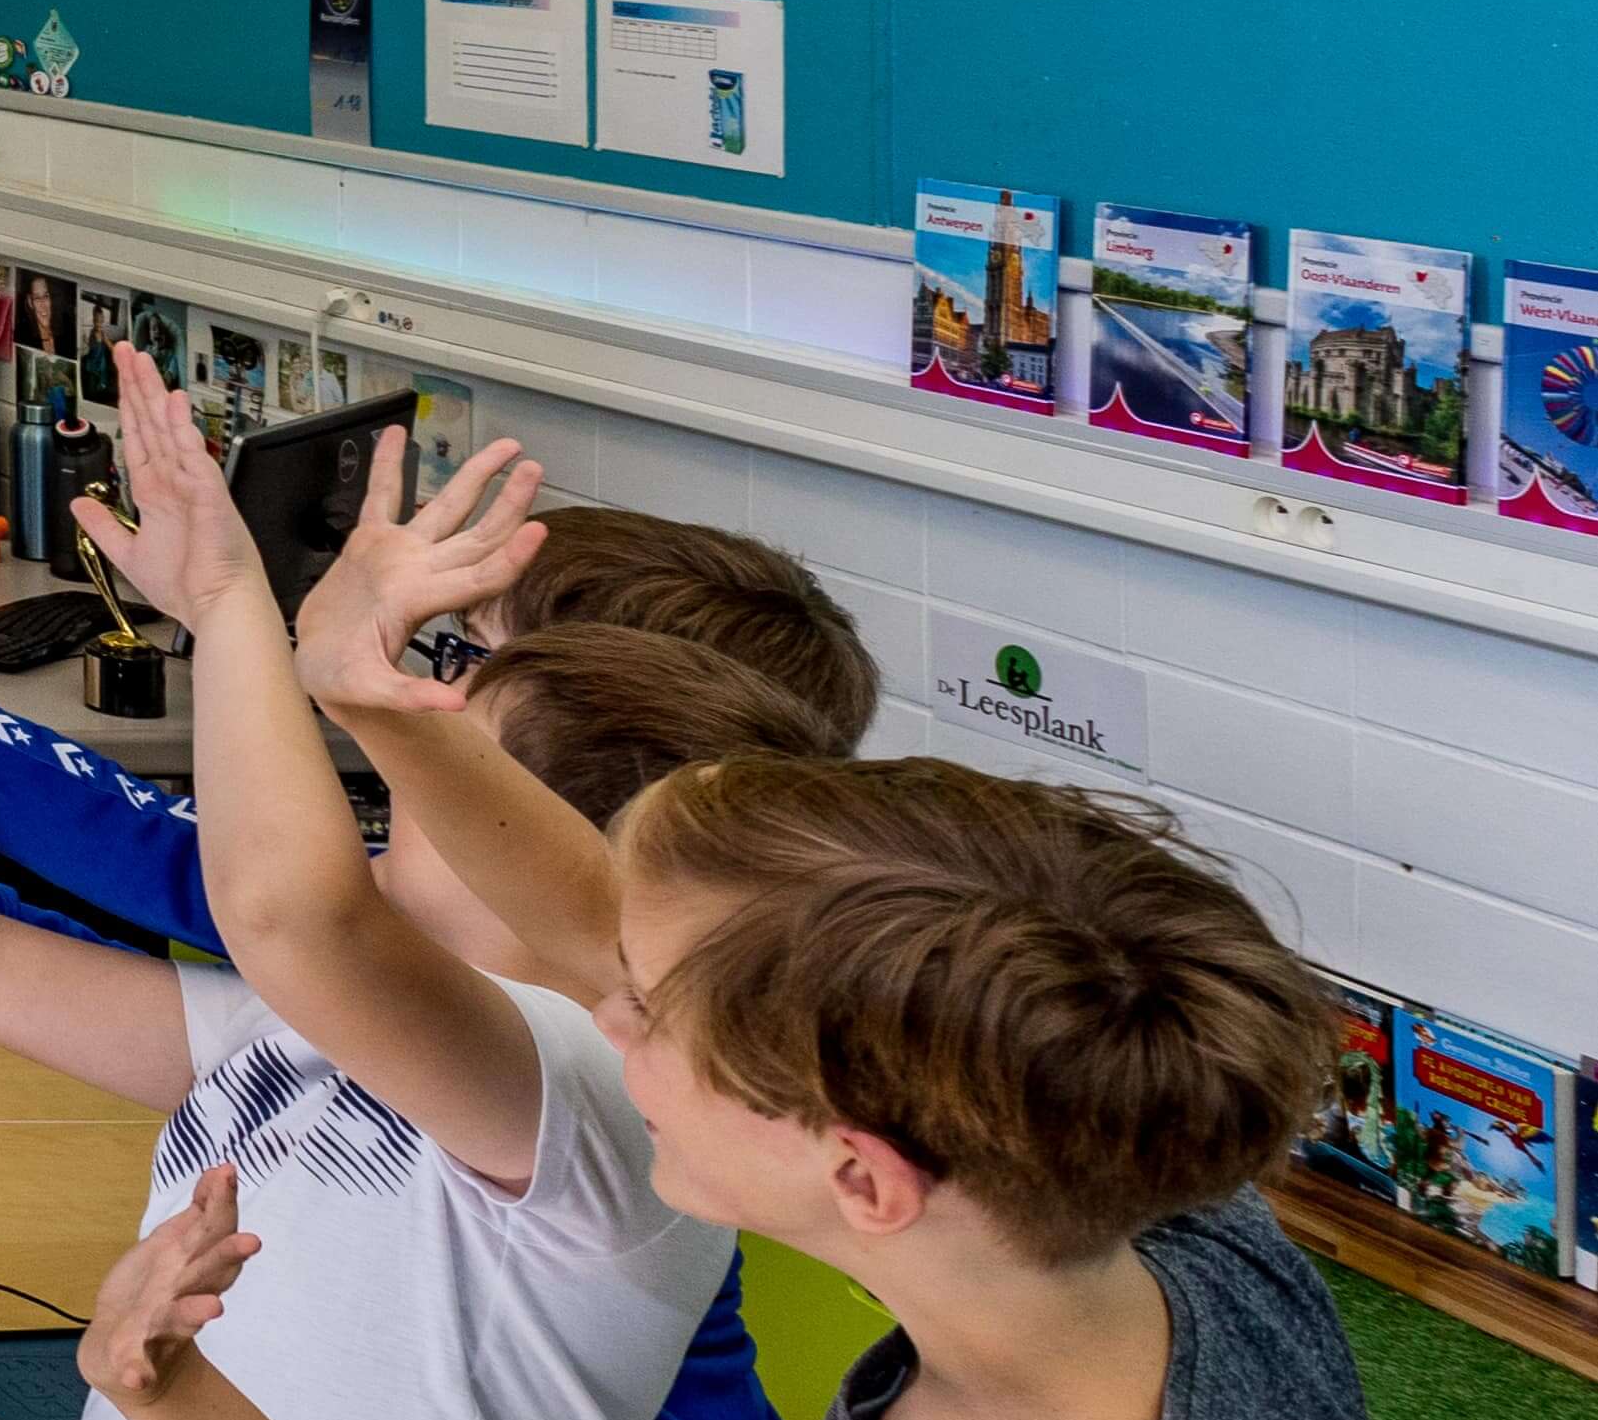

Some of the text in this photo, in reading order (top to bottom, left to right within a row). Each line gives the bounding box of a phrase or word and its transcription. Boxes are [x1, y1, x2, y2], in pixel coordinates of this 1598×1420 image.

[926, 216, 983, 233] Antwerpen
[1106, 241, 1155, 261] Limburg
[1301, 268, 1401, 294] Oost-Vlaanderen
[1521, 291, 1562, 304] Provincie
[938, 679, 956, 696] De
[958, 678, 1107, 753] Leesplank
